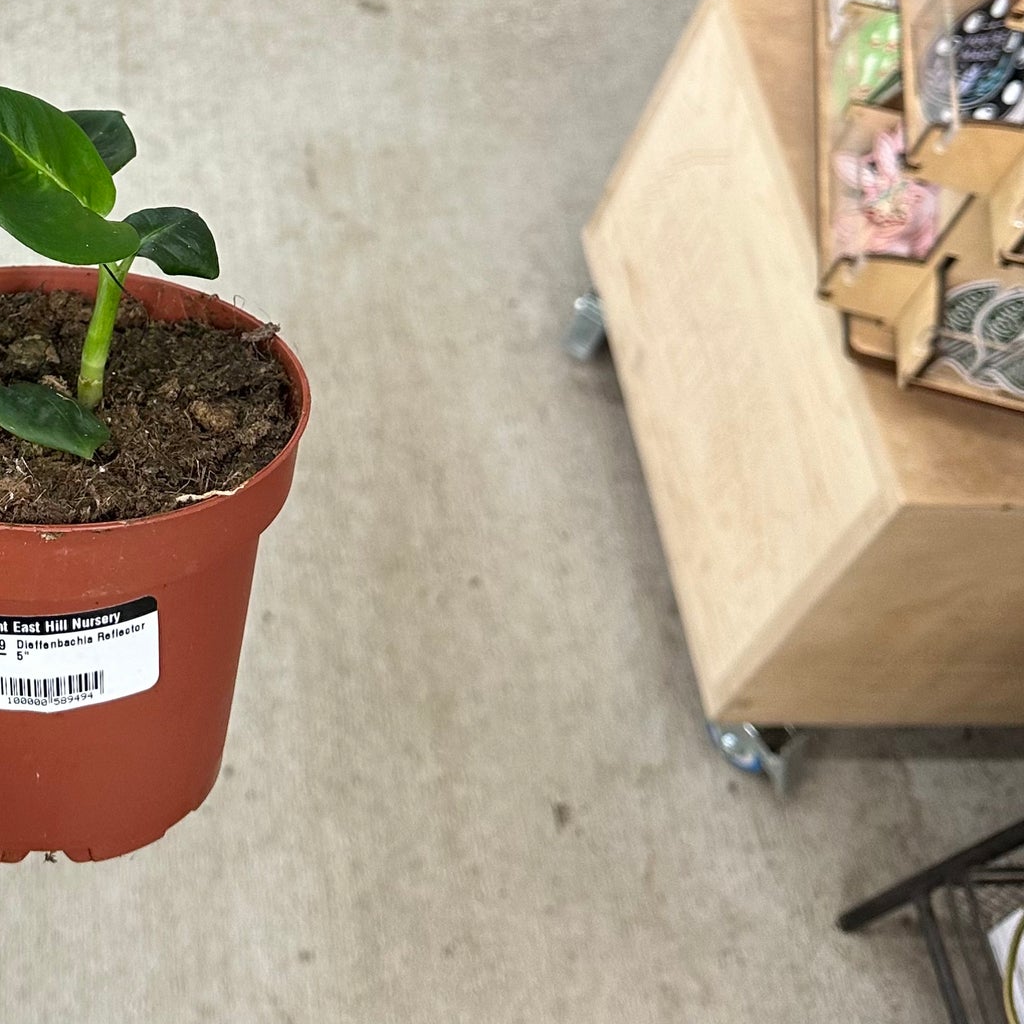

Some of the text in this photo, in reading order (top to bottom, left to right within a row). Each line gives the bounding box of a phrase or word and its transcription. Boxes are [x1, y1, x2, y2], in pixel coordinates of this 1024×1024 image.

[13, 621, 40, 633] East
[45, 619, 68, 632] Hill
[72, 612, 121, 630] Nursery
[16, 622, 146, 650] Dieffenbachia Reflector
[16, 651, 29, 661] 5"
[7, 697, 48, 706] 100000
[53, 692, 94, 705] 589494
